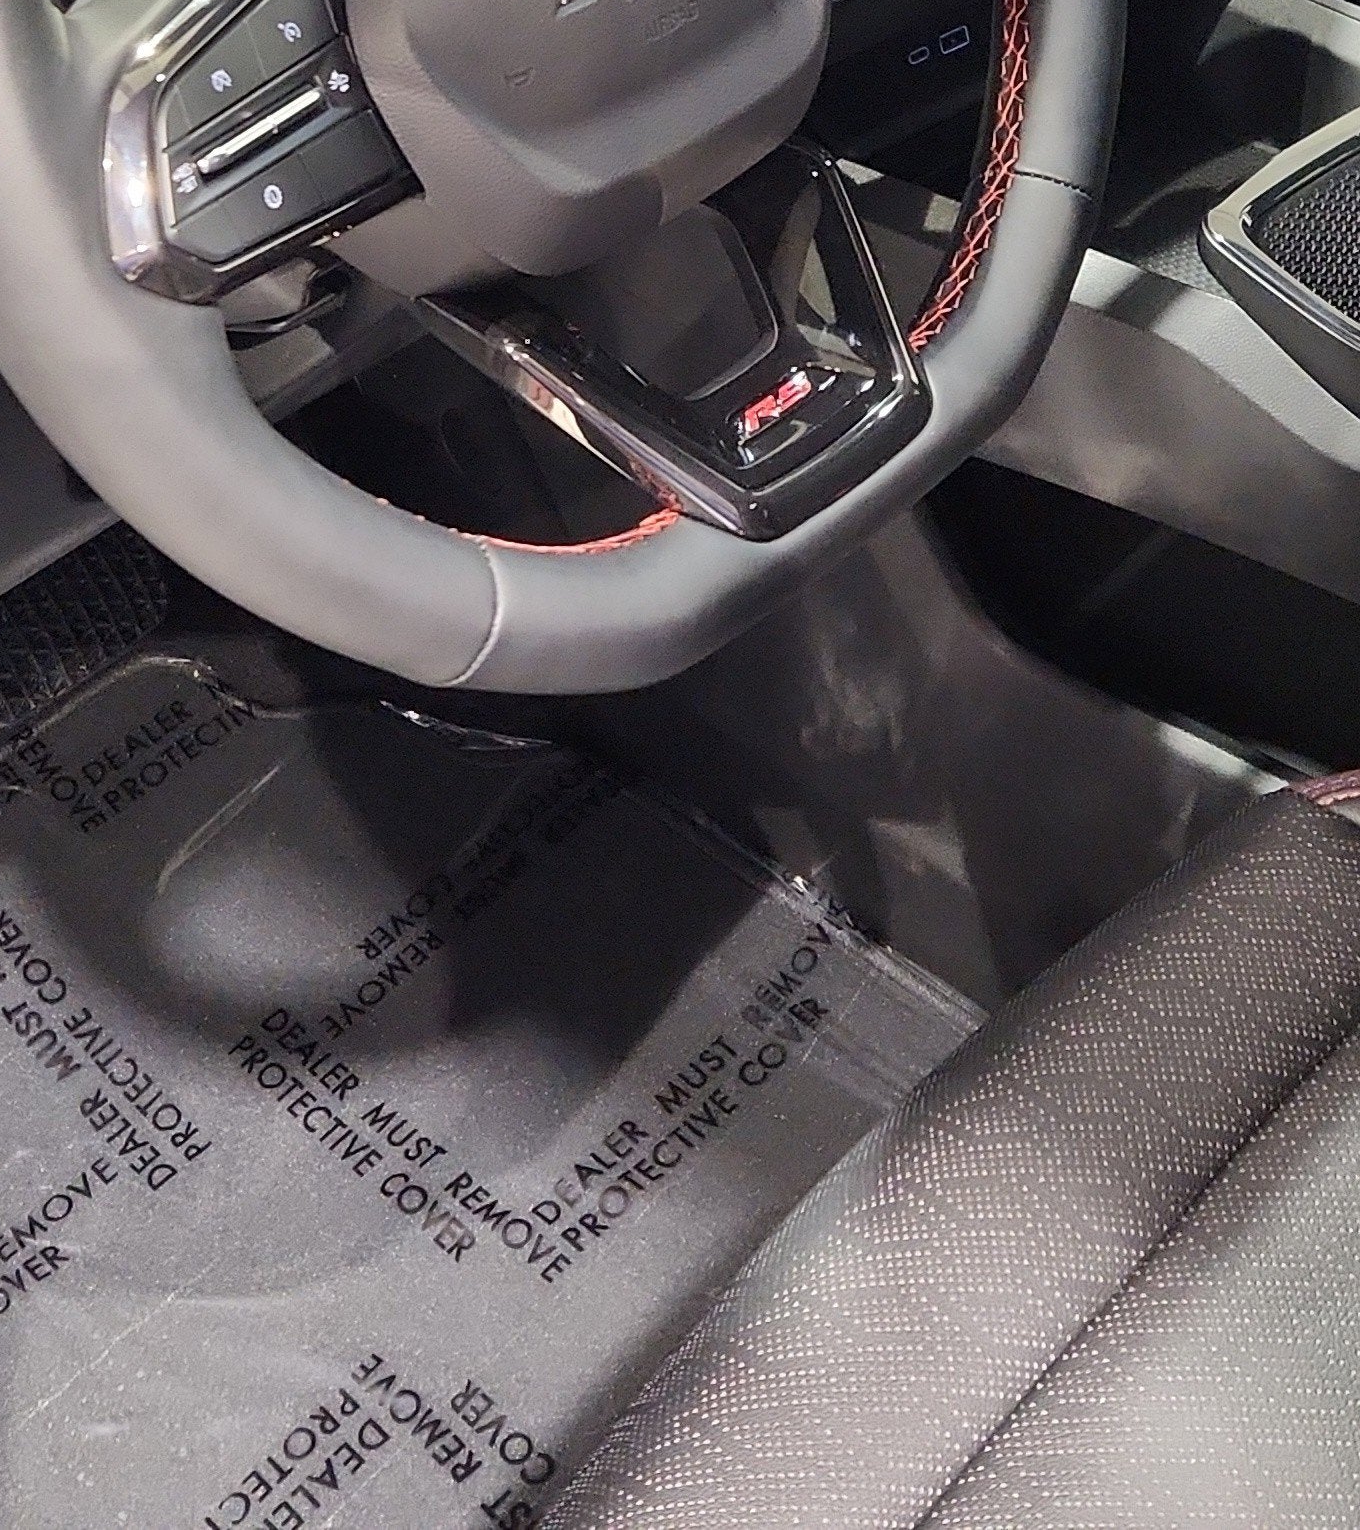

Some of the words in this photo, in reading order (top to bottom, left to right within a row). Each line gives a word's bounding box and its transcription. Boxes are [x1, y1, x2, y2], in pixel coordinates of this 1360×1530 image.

[82, 700, 193, 789] DEALER
[1, 1001, 81, 1083] MUST
[319, 928, 445, 1041] REMOVE
[62, 1006, 212, 1161] PROTECTIVE
[80, 1088, 178, 1190] DEALER
[228, 1035, 383, 1178] PROTECTIVE
[380, 1173, 476, 1263] COVER
[261, 1007, 360, 1101] DEALER
[361, 1102, 448, 1168] MUST
[444, 1171, 572, 1283] REMOVE
[531, 1120, 650, 1225] DEALER
[654, 1035, 739, 1115] MUST
[561, 1088, 739, 1252] PROTECTIVE
[740, 997, 830, 1087] COVER
[351, 1353, 483, 1484] REMOVE
[450, 1378, 557, 1486] COVER
